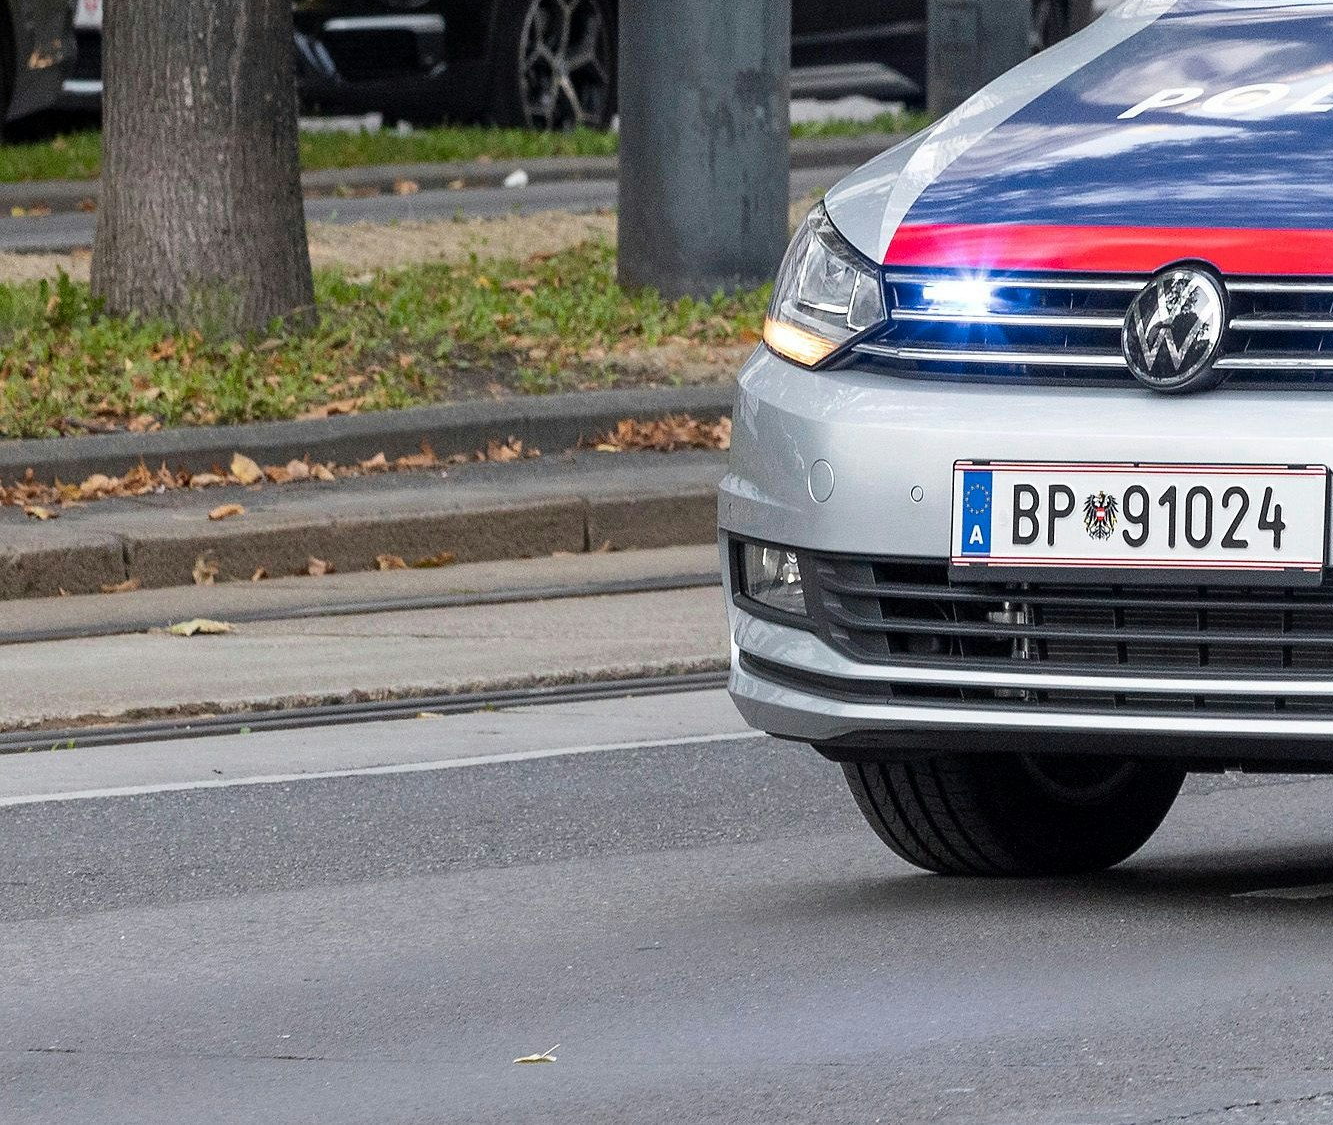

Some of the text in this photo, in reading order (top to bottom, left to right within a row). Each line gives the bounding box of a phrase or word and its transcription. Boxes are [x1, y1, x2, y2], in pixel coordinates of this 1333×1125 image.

[968, 524, 985, 545] A
[1012, 483, 1287, 550] BP 91024
